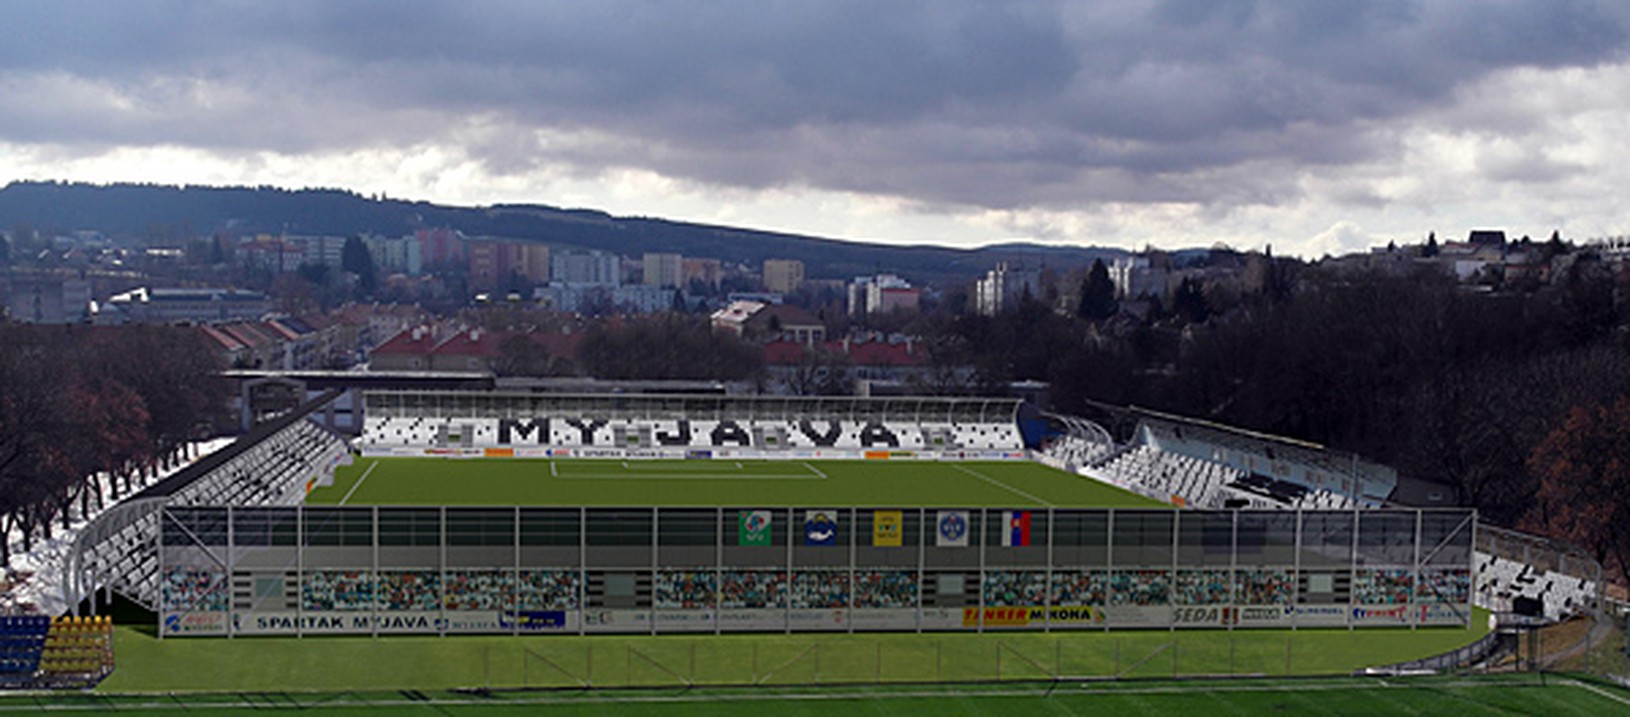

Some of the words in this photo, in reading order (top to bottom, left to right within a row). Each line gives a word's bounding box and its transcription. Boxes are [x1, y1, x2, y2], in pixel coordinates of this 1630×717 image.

[498, 418, 900, 445] MYJAVA
[1173, 607, 1219, 622] SEDA
[257, 616, 344, 629] SPARTAK
